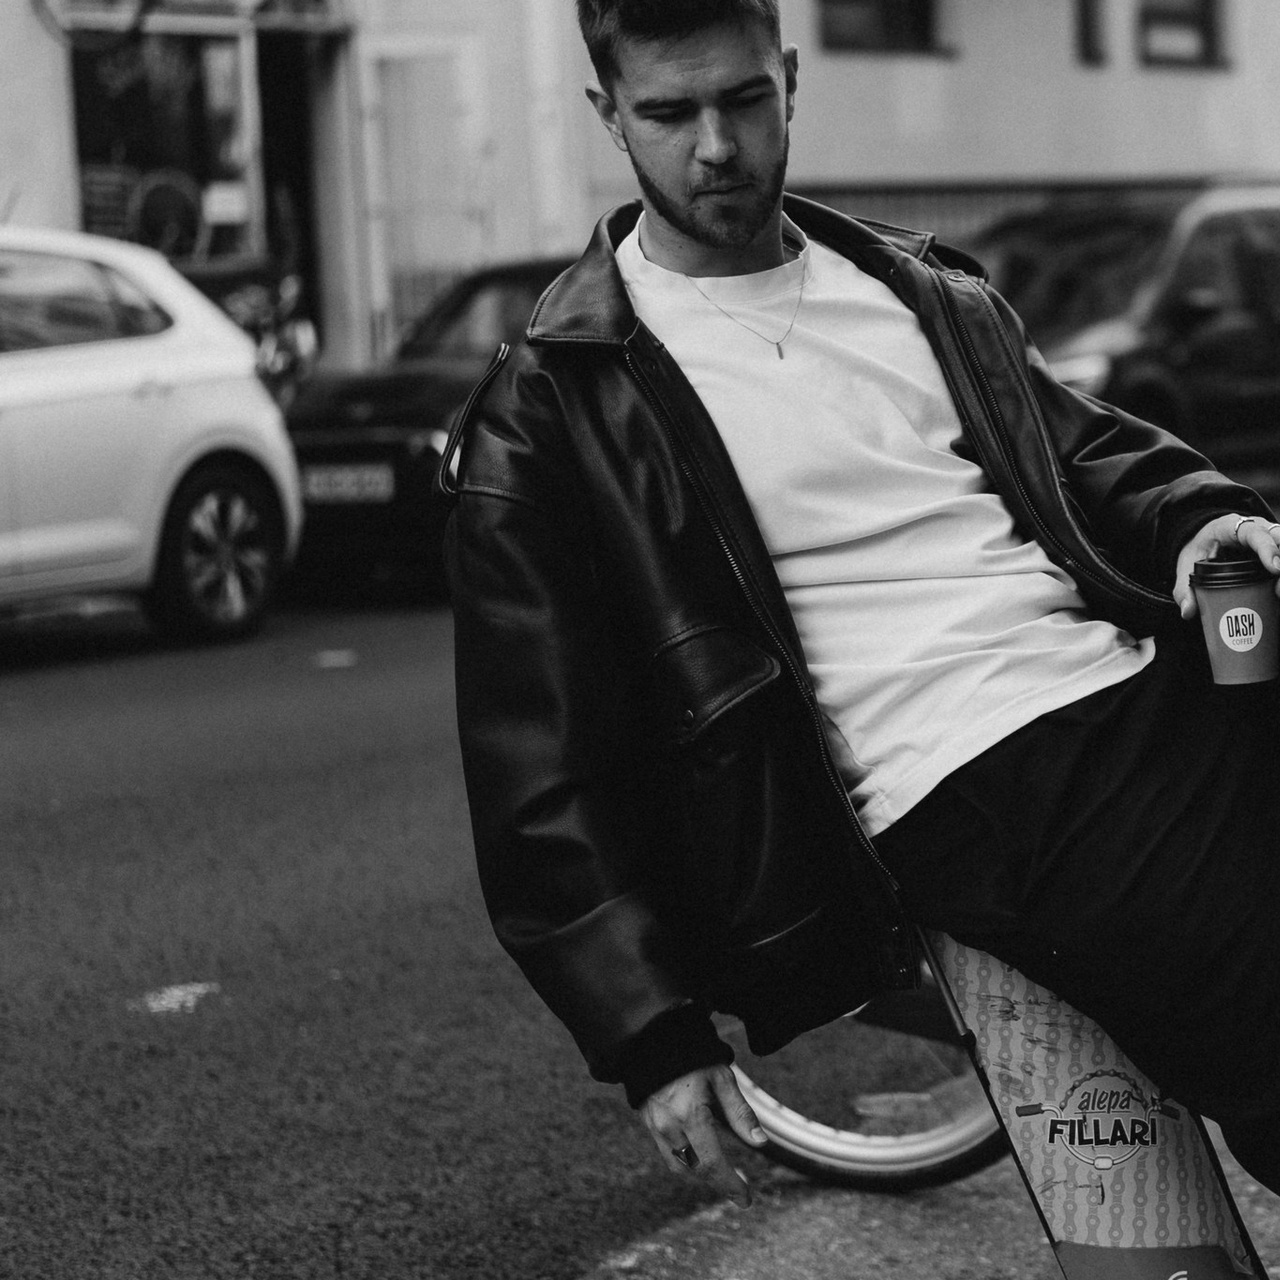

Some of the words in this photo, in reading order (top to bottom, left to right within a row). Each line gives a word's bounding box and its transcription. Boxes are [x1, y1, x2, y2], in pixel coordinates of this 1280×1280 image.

[1226, 613, 1255, 638] DASH
[1232, 637, 1253, 646] COFFEE
[1077, 1087, 1132, 1114] alepa
[1048, 1118, 1158, 1147] FILLARI
